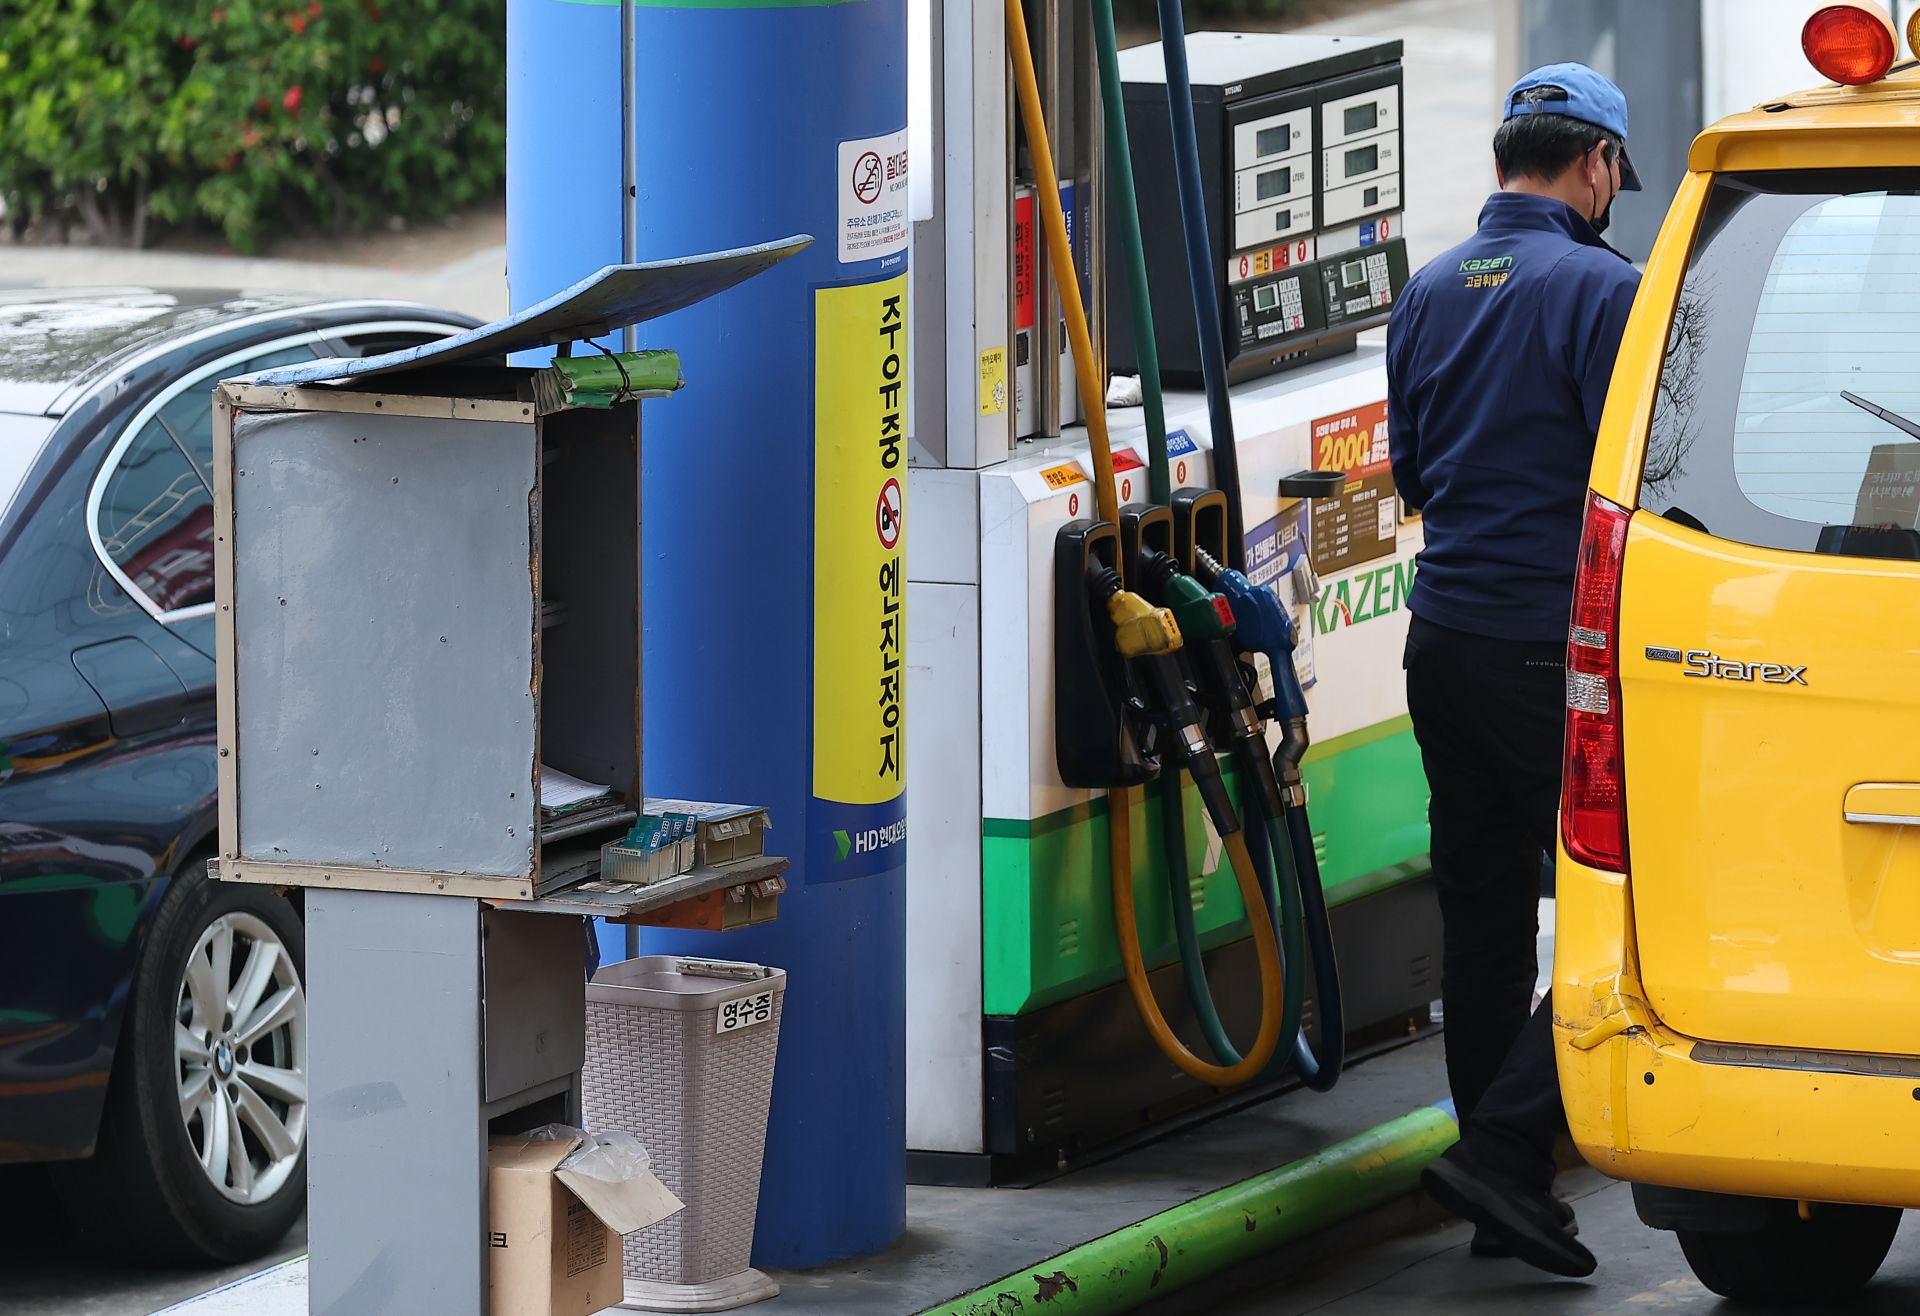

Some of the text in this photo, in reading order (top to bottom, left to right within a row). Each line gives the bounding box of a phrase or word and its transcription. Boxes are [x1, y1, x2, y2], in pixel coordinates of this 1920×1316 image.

[847, 217, 866, 229] 주유소
[878, 295, 902, 782] 주유중 엔진정지
[1276, 521, 1299, 550] 다르다
[1311, 558, 1417, 637] KAZEN
[1684, 649, 1808, 686] Starex
[855, 818, 907, 854] HD현대오일
[723, 993, 771, 1029] 영수증
[488, 1231, 509, 1249] 크
